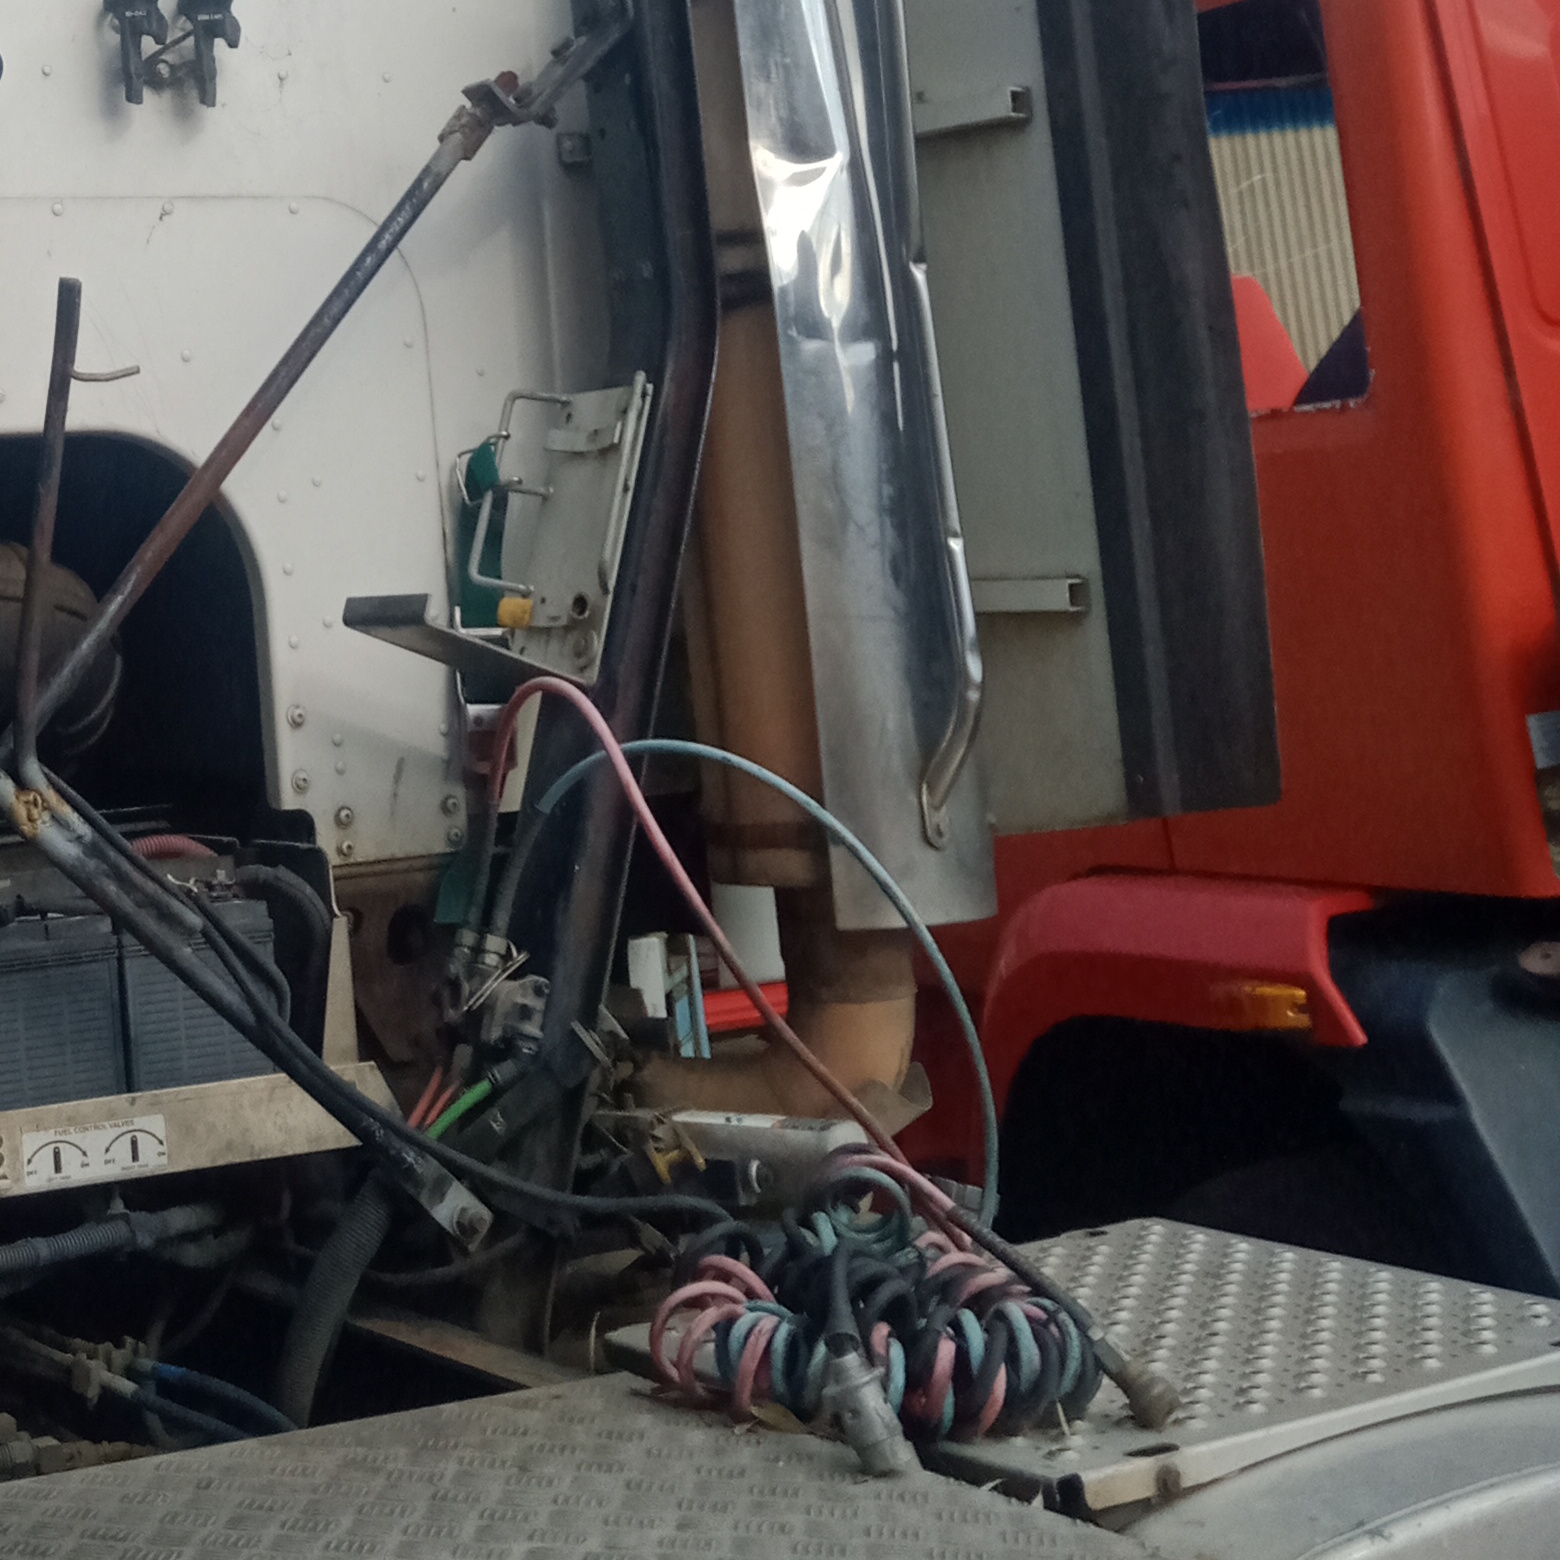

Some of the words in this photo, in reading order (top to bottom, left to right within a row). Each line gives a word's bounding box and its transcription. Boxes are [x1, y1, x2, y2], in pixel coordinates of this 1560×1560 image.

[54, 1128, 72, 1137] FUEL
[73, 1123, 108, 1135] CONTROL
[109, 1120, 135, 1129] VALVES
